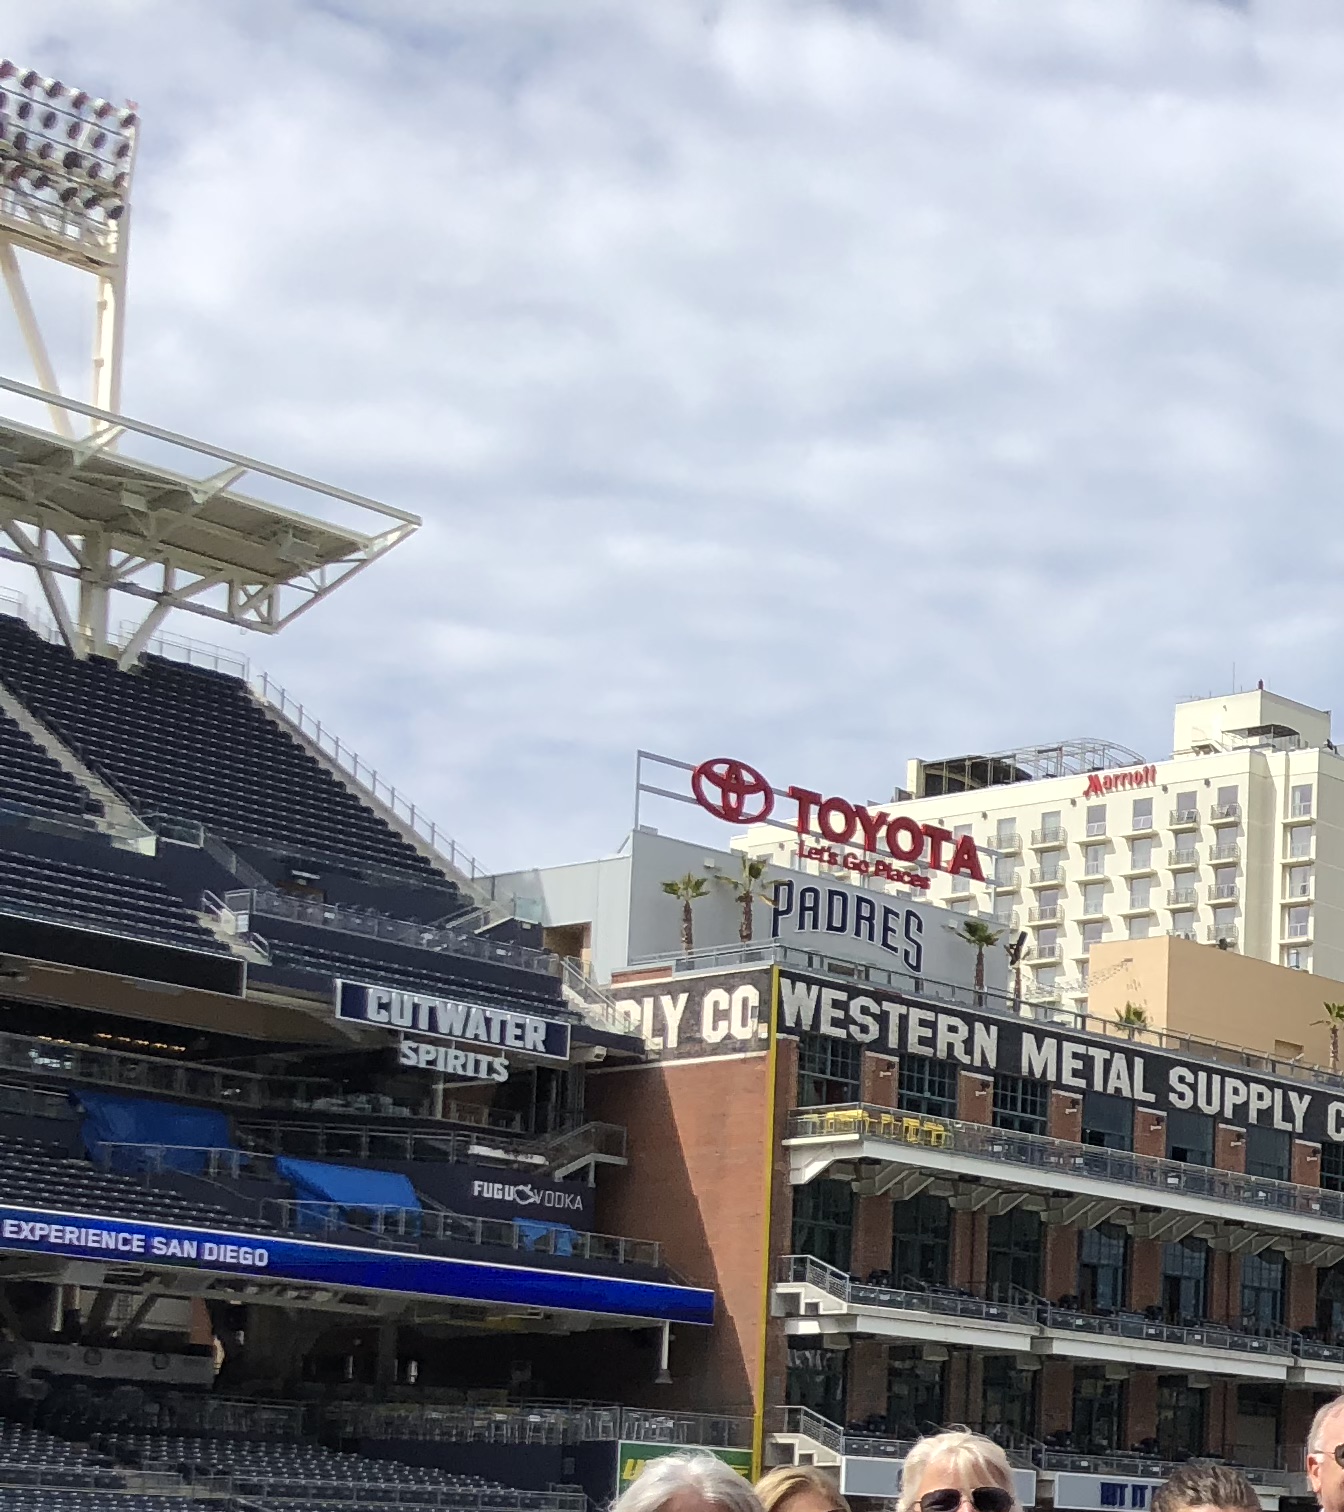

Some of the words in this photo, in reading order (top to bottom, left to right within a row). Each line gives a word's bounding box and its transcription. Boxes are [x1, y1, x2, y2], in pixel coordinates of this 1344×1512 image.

[1083, 765, 1157, 798] Marriott
[788, 785, 986, 882] TOYOTA
[842, 852, 869, 874] Go
[770, 879, 924, 975] PADRES
[366, 988, 547, 1053] CUTWATER
[701, 984, 768, 1044] CO.
[400, 1040, 510, 1083] SPIRITS
[778, 977, 998, 1069] WESTERN
[1020, 1032, 1156, 1103] METAL
[1168, 1066, 1313, 1134] SUPPLY
[472, 1180, 515, 1201] FUGU
[534, 1188, 584, 1211] VODKA
[2, 1218, 146, 1253] EXPERIENCE
[151, 1236, 198, 1259] SAN
[203, 1242, 269, 1267] DIEGO
